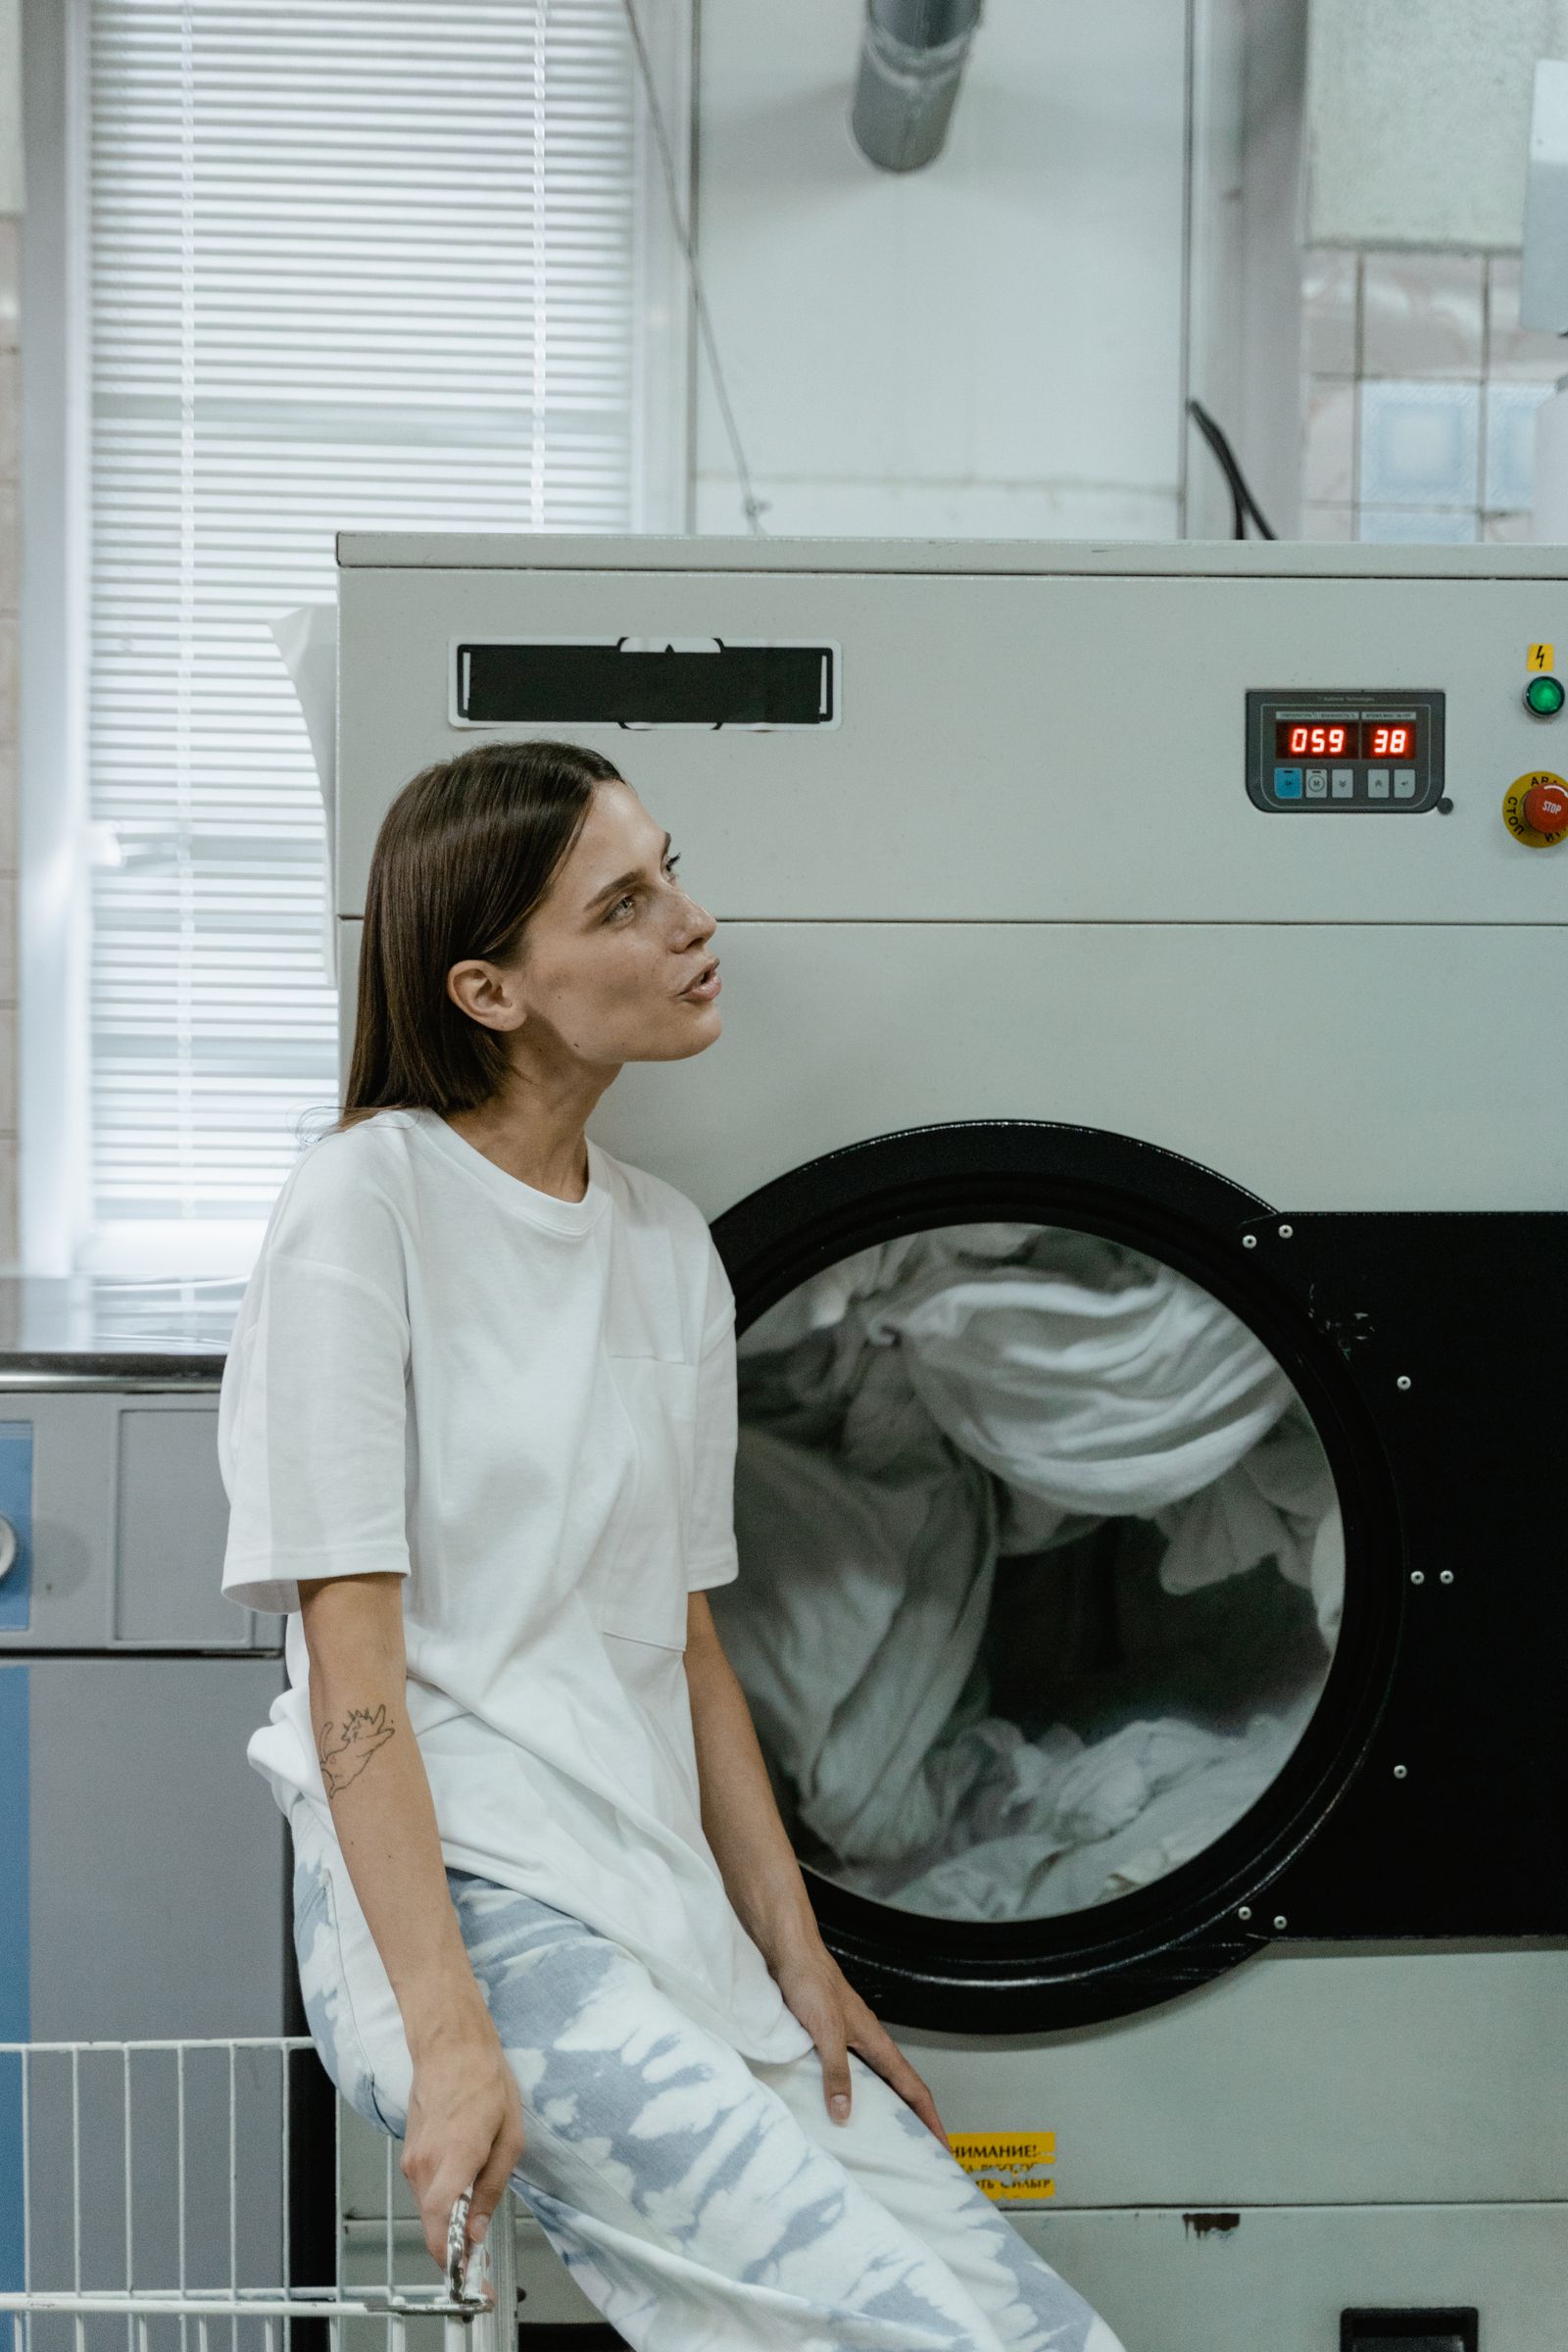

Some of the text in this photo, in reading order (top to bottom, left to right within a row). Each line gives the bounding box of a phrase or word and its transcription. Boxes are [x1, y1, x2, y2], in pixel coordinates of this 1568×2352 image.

[1291, 728, 1406, 754] 059 38
[1542, 800, 1562, 815] STOP
[951, 2144, 1037, 2158] НИМАНИЕ!
